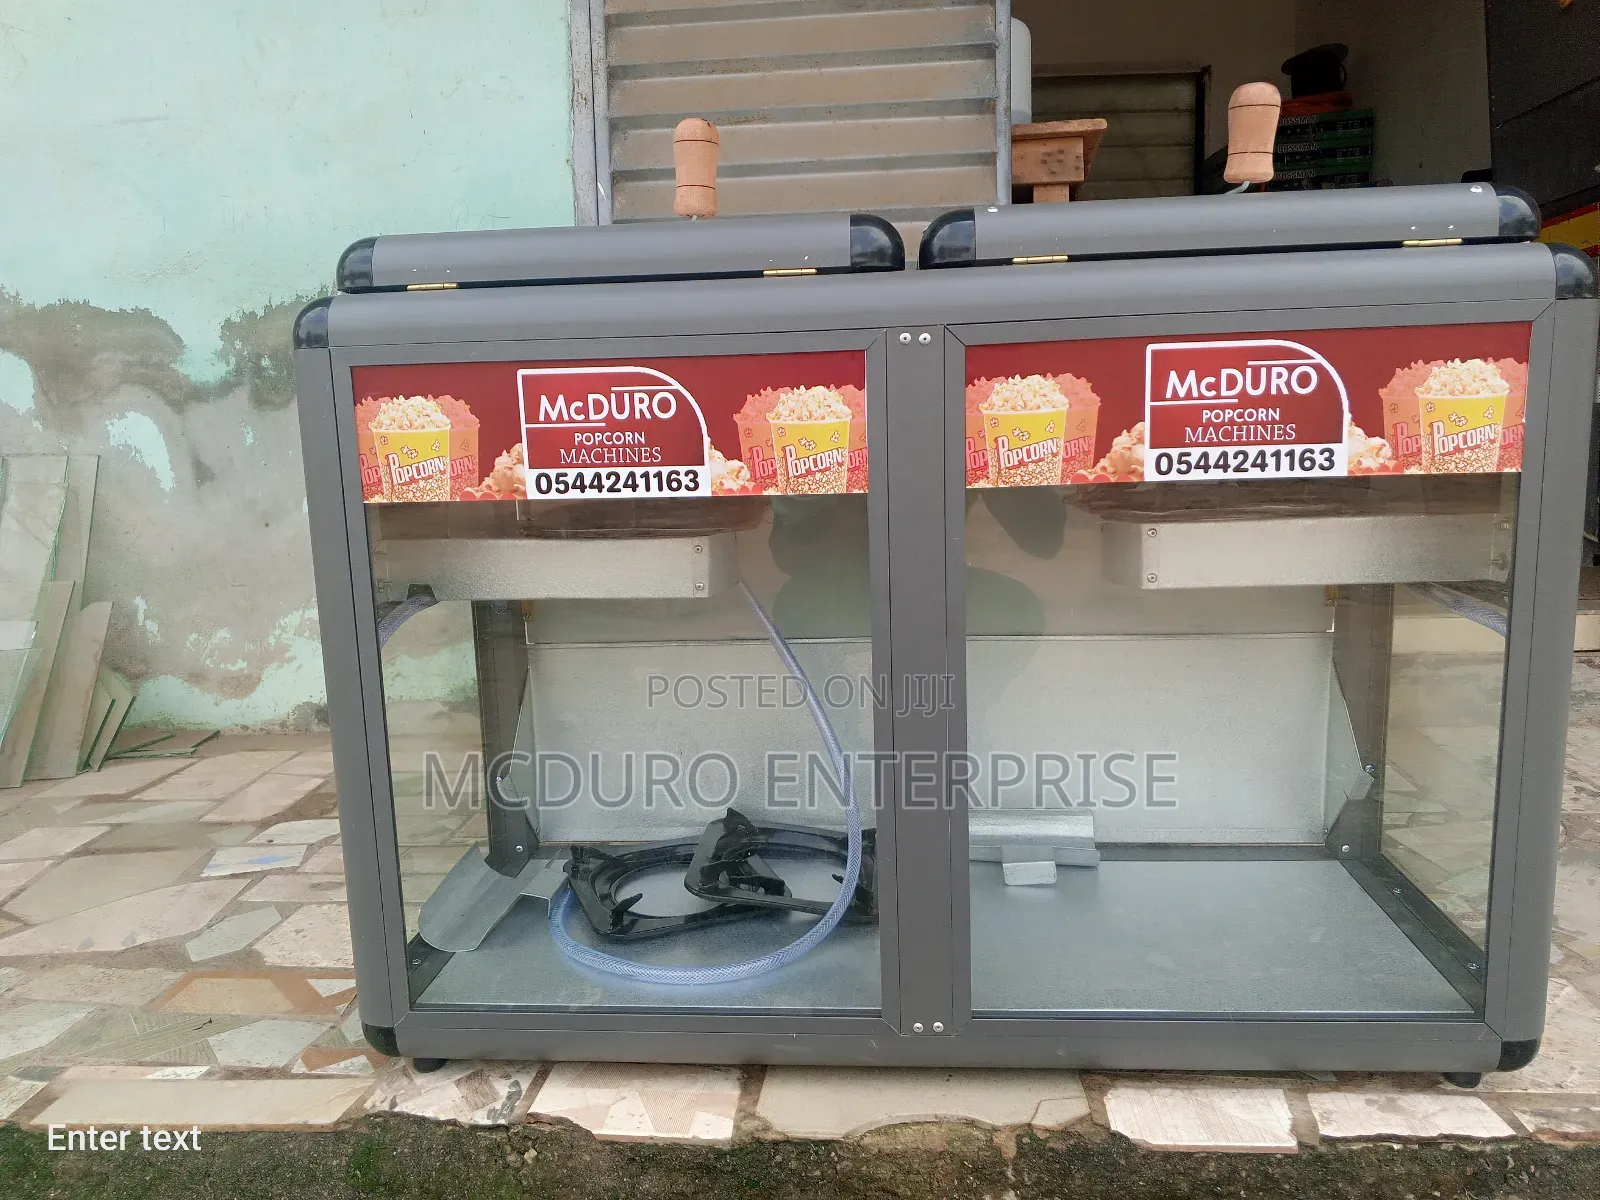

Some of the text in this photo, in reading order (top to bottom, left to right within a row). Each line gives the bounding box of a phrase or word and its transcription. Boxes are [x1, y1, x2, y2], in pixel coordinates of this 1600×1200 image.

[1165, 365, 1318, 399] McDURO
[538, 391, 677, 422] McDURO
[1202, 407, 1280, 423] POPCORN
[574, 431, 645, 446] POPCORN
[1184, 423, 1296, 443] MACHINES
[1430, 419, 1497, 457] POPCORN
[559, 446, 662, 464] MACHINES
[783, 444, 843, 480] POPCORN
[995, 435, 1059, 470] POPCORN
[1154, 447, 1335, 476] 0544241163
[386, 452, 445, 486] POPCORN
[535, 469, 700, 495] 0544241163
